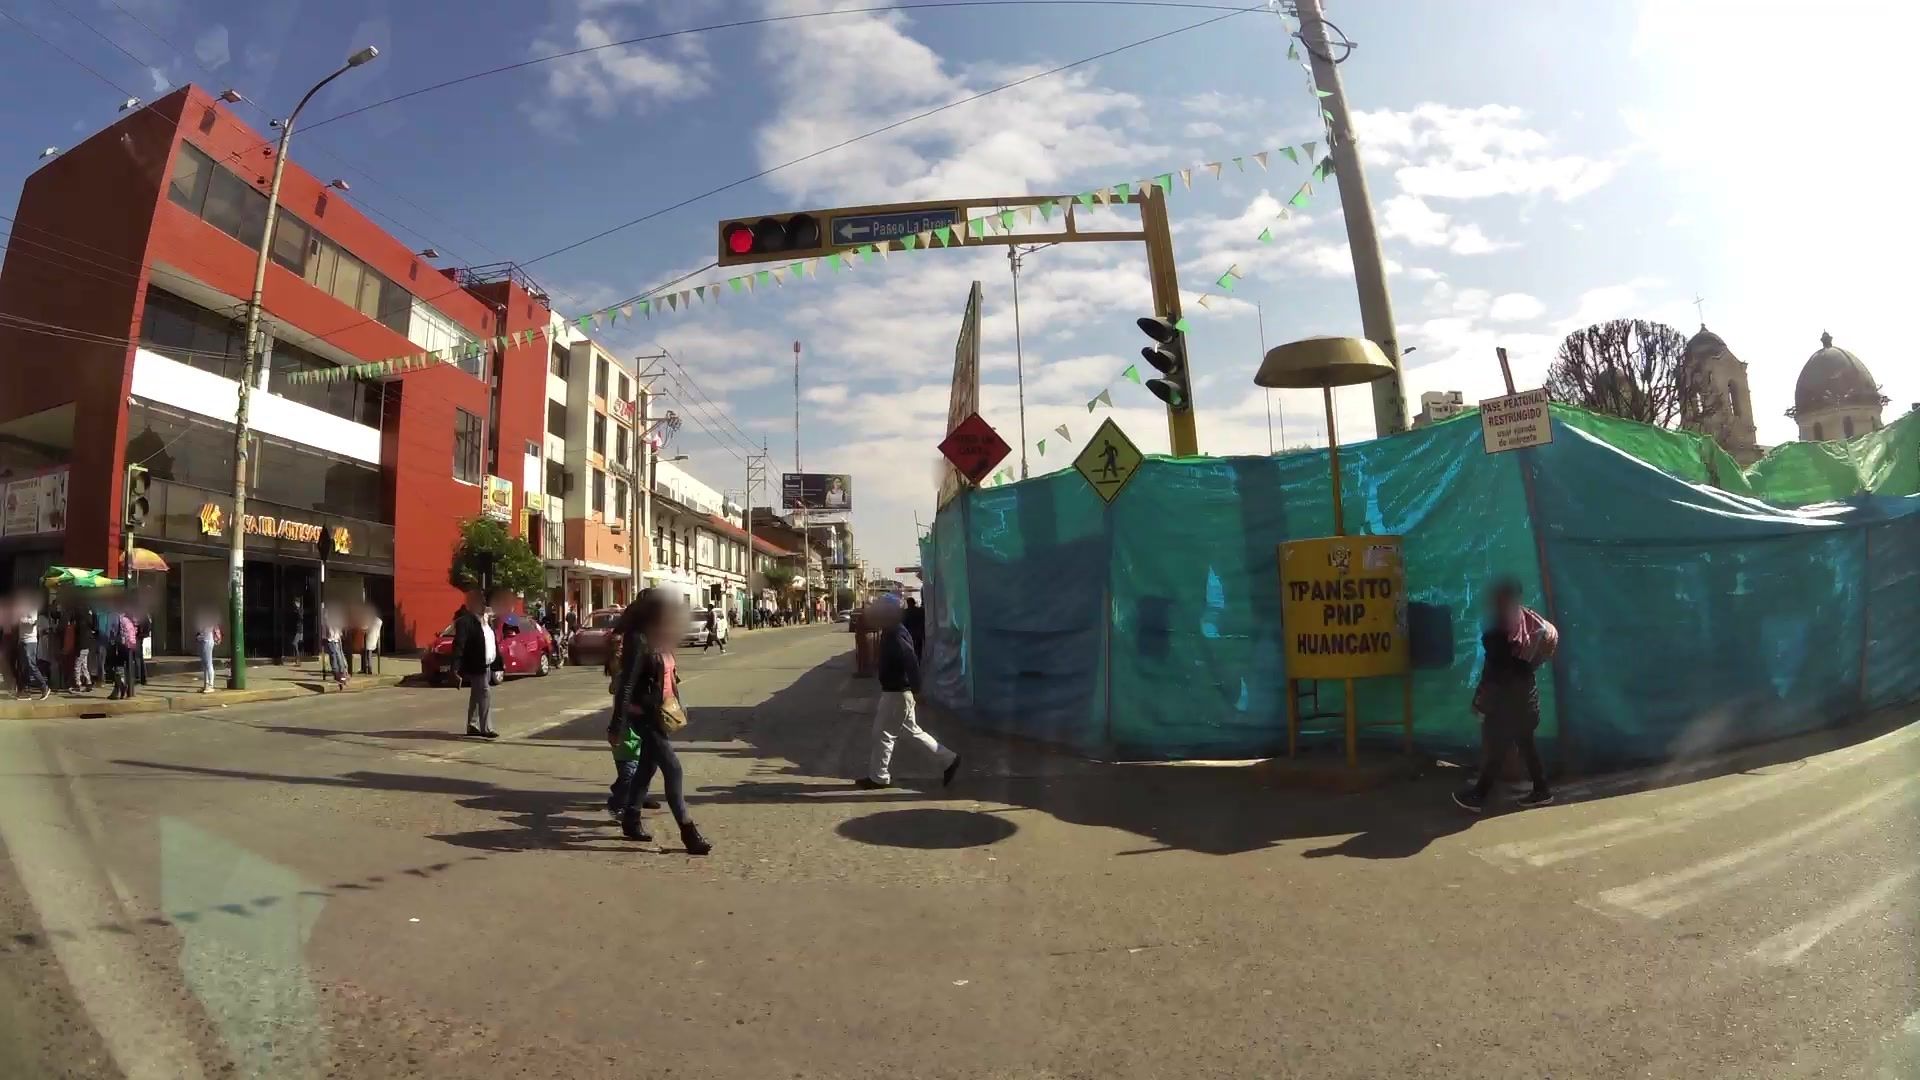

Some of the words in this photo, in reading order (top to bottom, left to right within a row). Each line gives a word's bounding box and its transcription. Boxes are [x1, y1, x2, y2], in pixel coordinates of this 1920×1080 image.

[873, 221, 904, 236] Paseo
[906, 219, 919, 233] La
[1488, 408, 1541, 427] RESTRINGIDO
[1323, 604, 1366, 626] PNP
[1297, 632, 1391, 655] HUANCAYO
